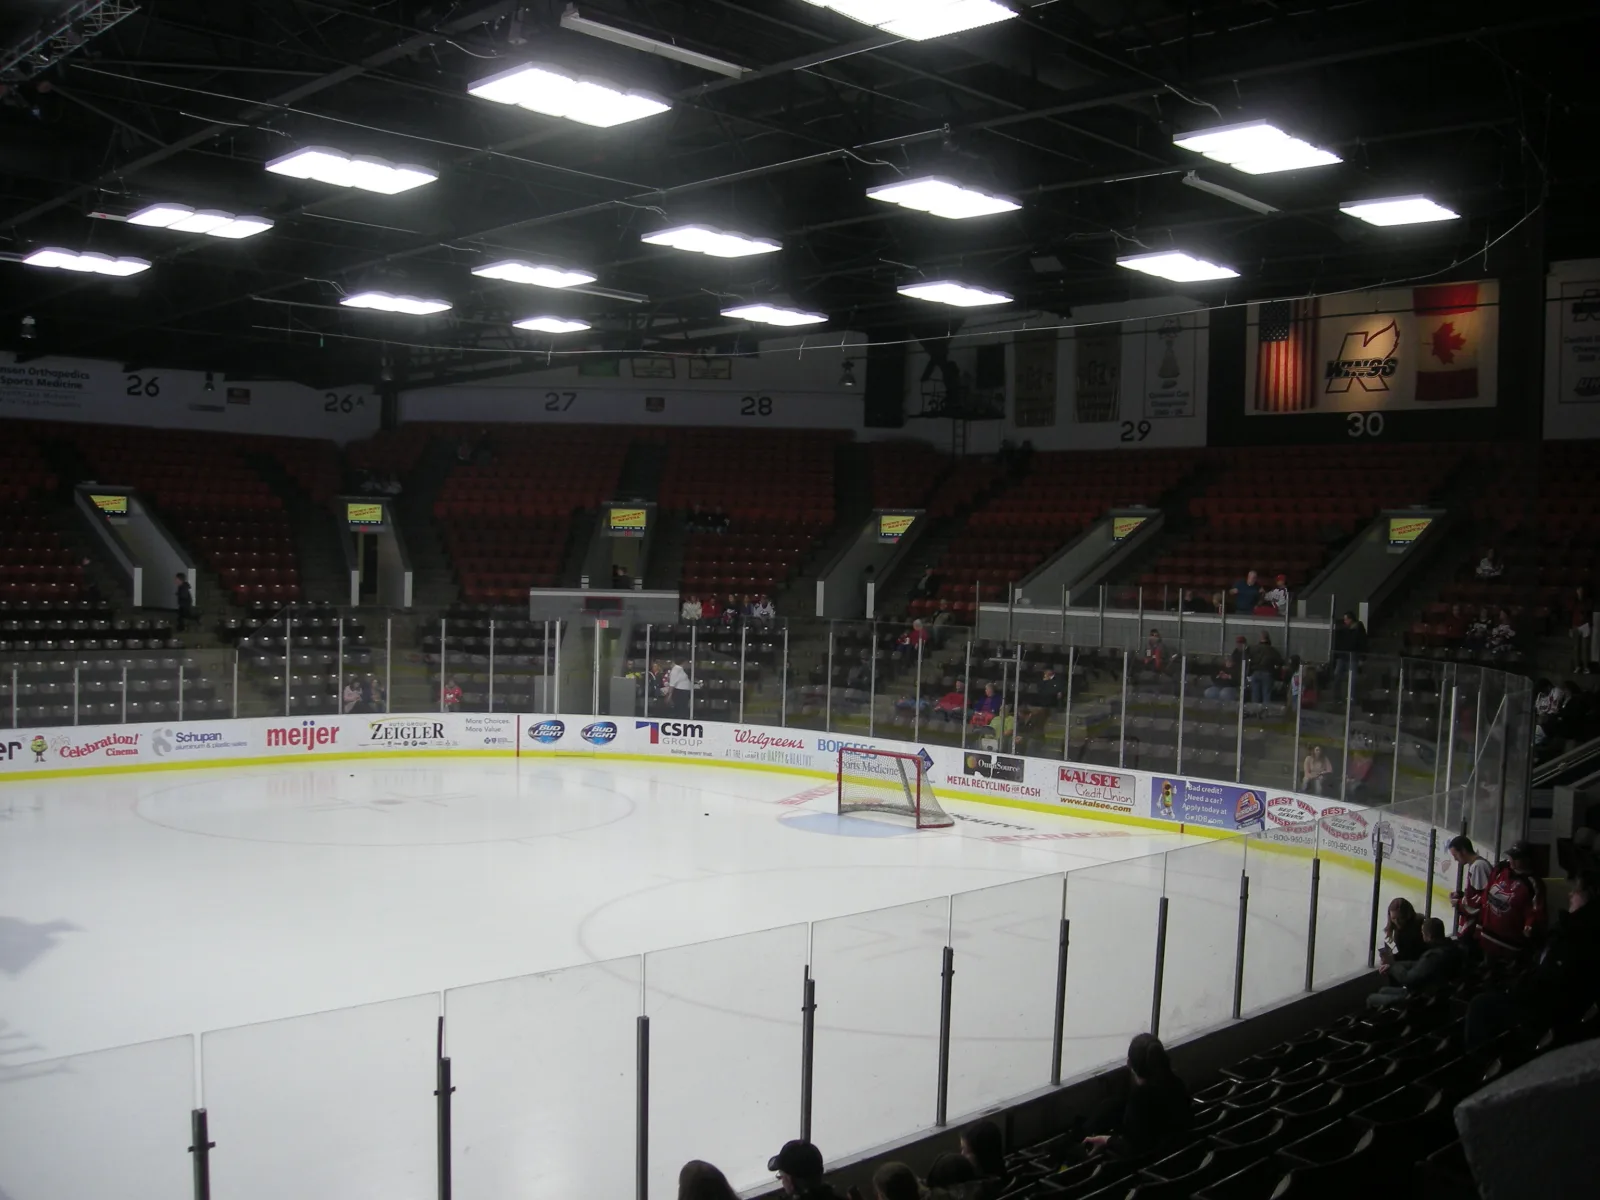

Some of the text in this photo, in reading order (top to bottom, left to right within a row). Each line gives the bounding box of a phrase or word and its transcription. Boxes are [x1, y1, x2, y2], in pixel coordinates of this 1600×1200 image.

[28, 367, 90, 380] Orthopedics
[1325, 357, 1399, 380] WINGS
[1, 376, 83, 390] Sports Medicine
[126, 374, 160, 397] 26
[544, 392, 577, 412] 27
[741, 396, 773, 416] 28
[1120, 420, 1151, 442] 29
[1346, 412, 1384, 437] 30
[267, 720, 340, 750] meijer
[371, 722, 444, 740] ZEIGLER
[534, 730, 563, 738] LIGHT
[539, 724, 561, 732] BUD
[586, 731, 616, 739] LIGHT
[661, 722, 703, 738] csm
[60, 733, 140, 758] Celebration!
[176, 731, 222, 745] Schupan
[663, 737, 703, 748] GROUP
[734, 729, 805, 749] Walgreens
[106, 747, 139, 757] Cinema
[861, 760, 900, 777] Medicine
[947, 775, 971, 787] METAL
[971, 778, 1011, 793] RECYCLING
[1020, 786, 1041, 797] CASH
[1060, 768, 1121, 789] KALSEE
[1075, 783, 1133, 803] Credit Union
[1187, 793, 1204, 802] Need
[1188, 784, 1223, 795] Bad credit?
[1060, 797, 1131, 813] www.kalsee.com
[1182, 803, 1201, 812] Apply
[1202, 806, 1220, 815] today
[1267, 796, 1318, 816] BEST WAY
[1277, 812, 1305, 820] SERVICE
[1321, 807, 1369, 828] BEST WAY
[1320, 822, 1369, 841] DISPOSAL
